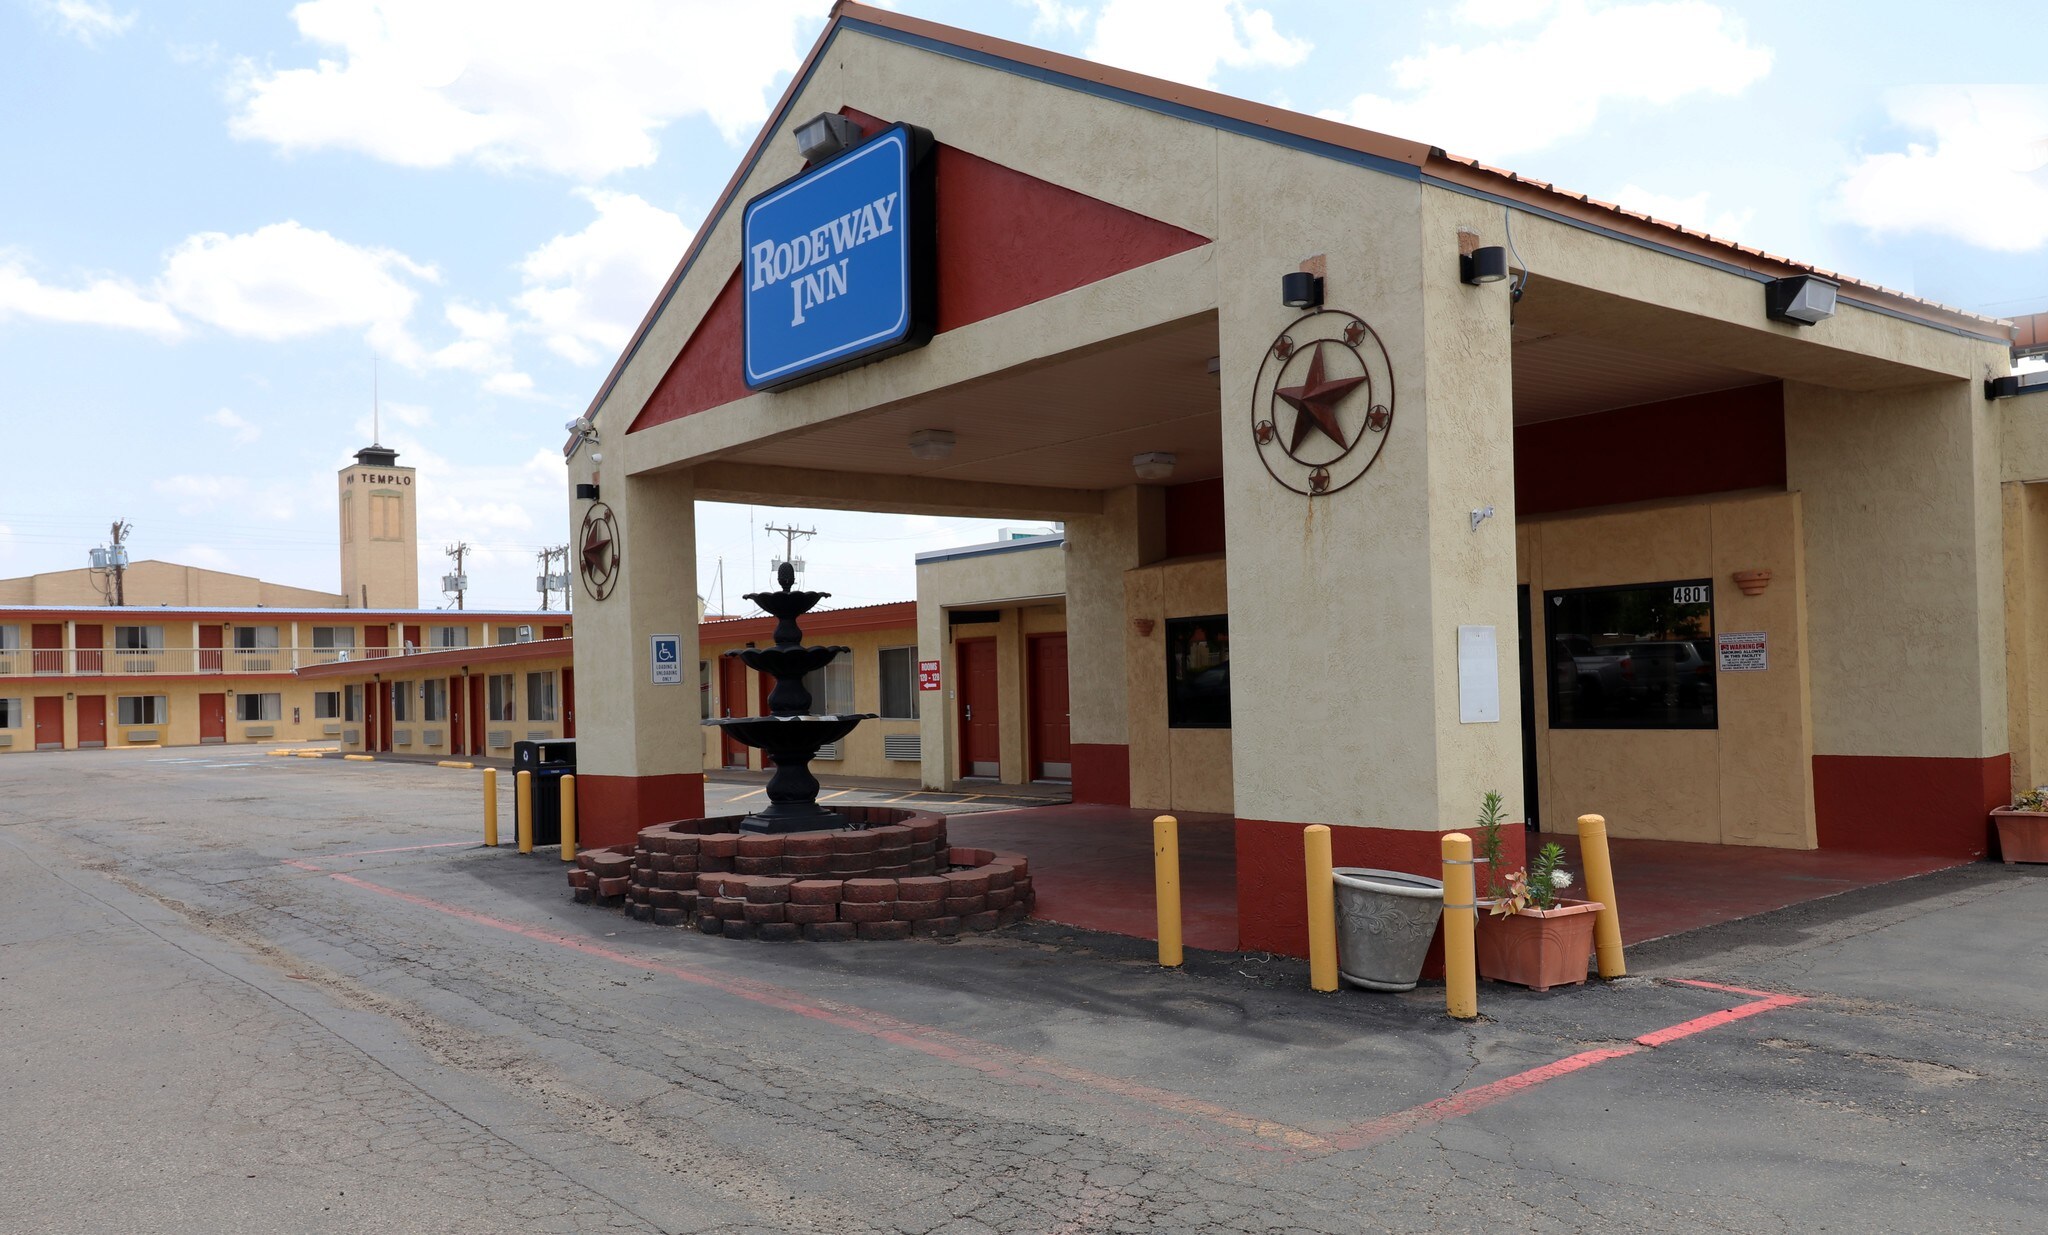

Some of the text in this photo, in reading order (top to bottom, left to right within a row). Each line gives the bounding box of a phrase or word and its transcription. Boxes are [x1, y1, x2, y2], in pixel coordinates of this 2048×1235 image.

[791, 258, 849, 327] INN
[361, 474, 411, 486] TEMPLO
[1675, 587, 1709, 602] 4801
[921, 662, 937, 671] ROOMS
